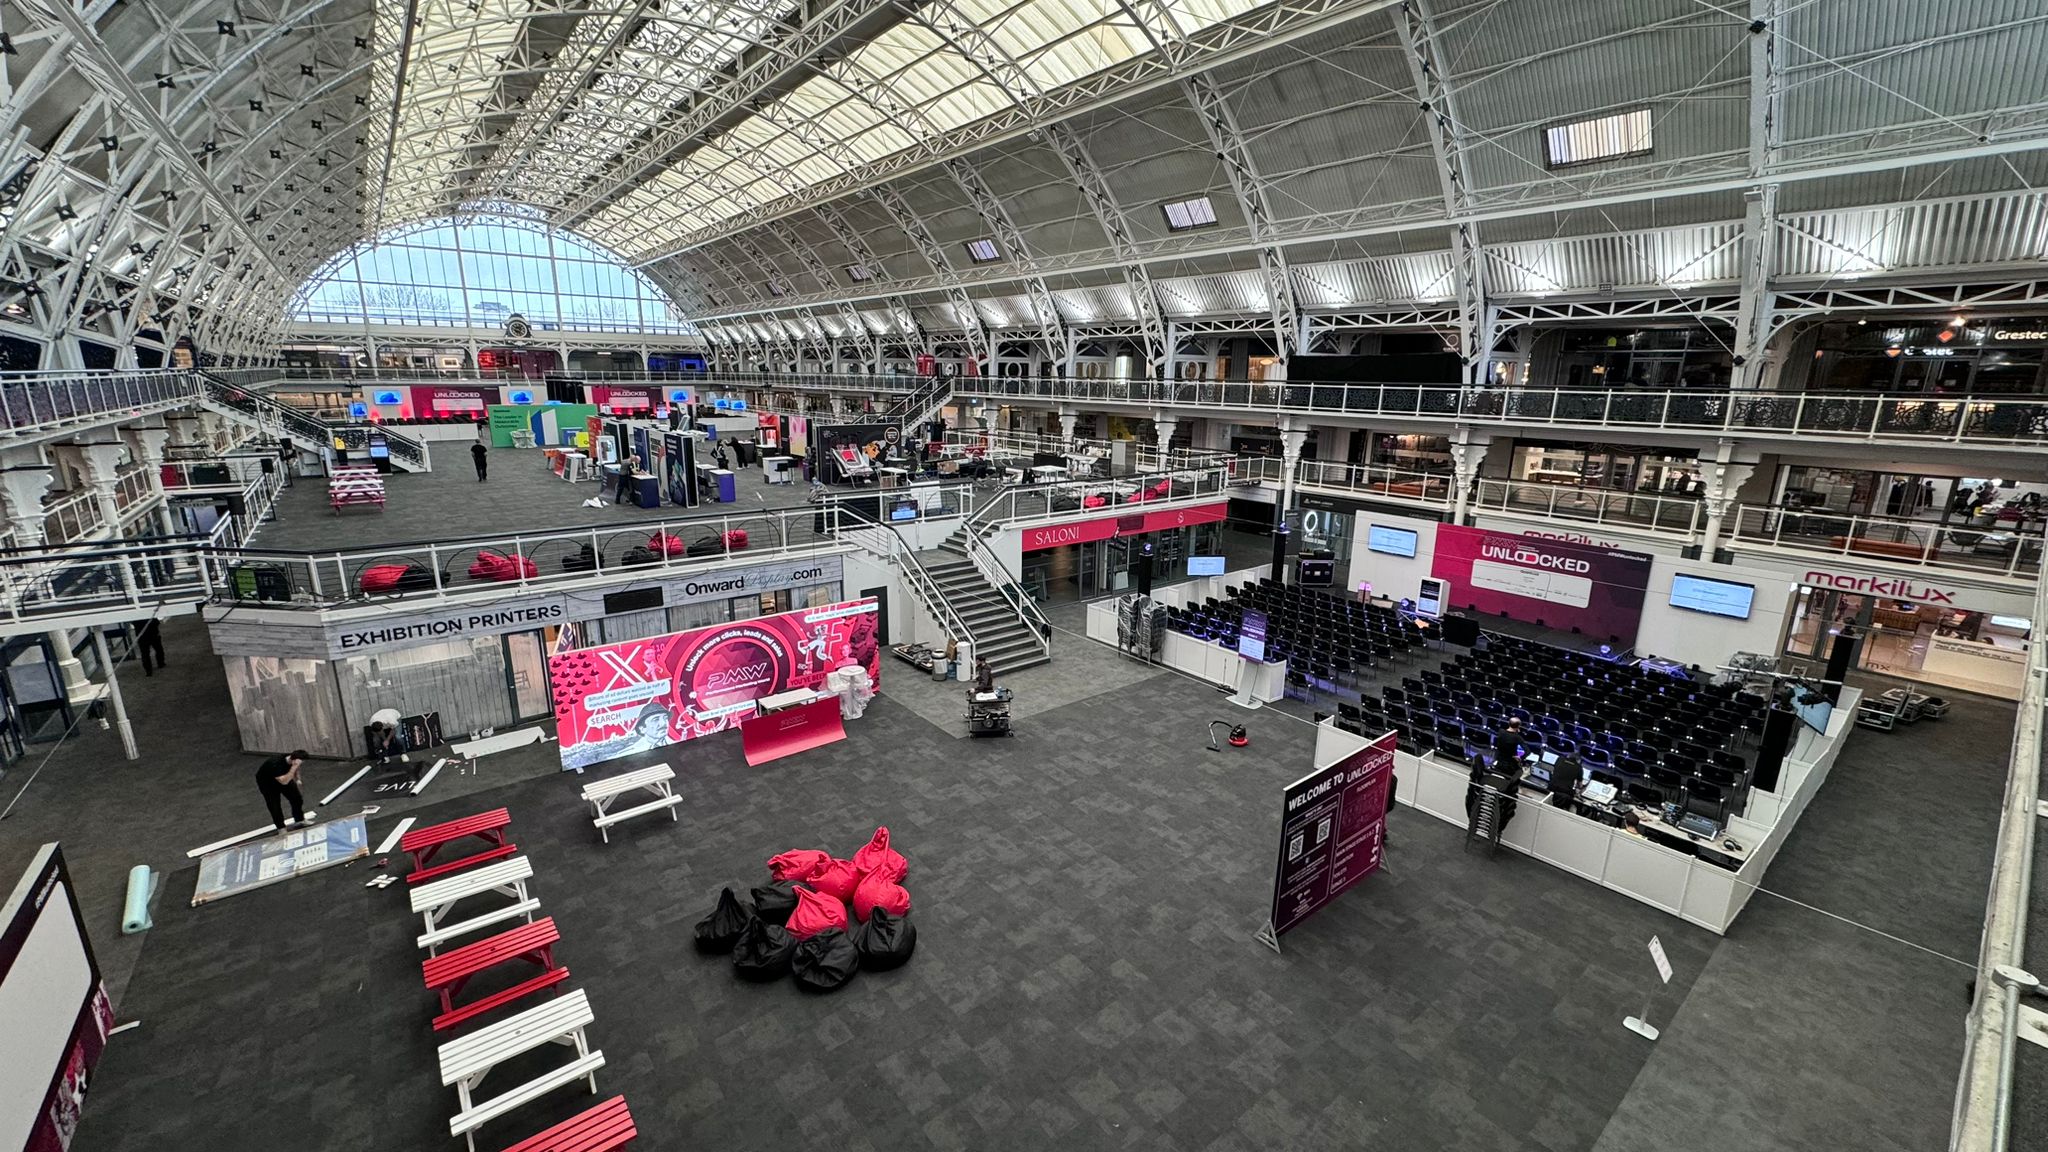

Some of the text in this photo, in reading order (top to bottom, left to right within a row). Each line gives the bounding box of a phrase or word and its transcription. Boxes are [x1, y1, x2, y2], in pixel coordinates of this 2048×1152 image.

[1994, 330, 2047, 340] Grestec
[1035, 526, 1080, 546] SALONI
[1804, 571, 1956, 604] markilux
[340, 604, 562, 648] EXHIBITION PRINTERS
[707, 662, 767, 689] PMW
[590, 713, 622, 725] SEARCH
[374, 781, 416, 793] LIVE
[1288, 777, 1333, 812] WELCOME
[1333, 772, 1345, 786] TO
